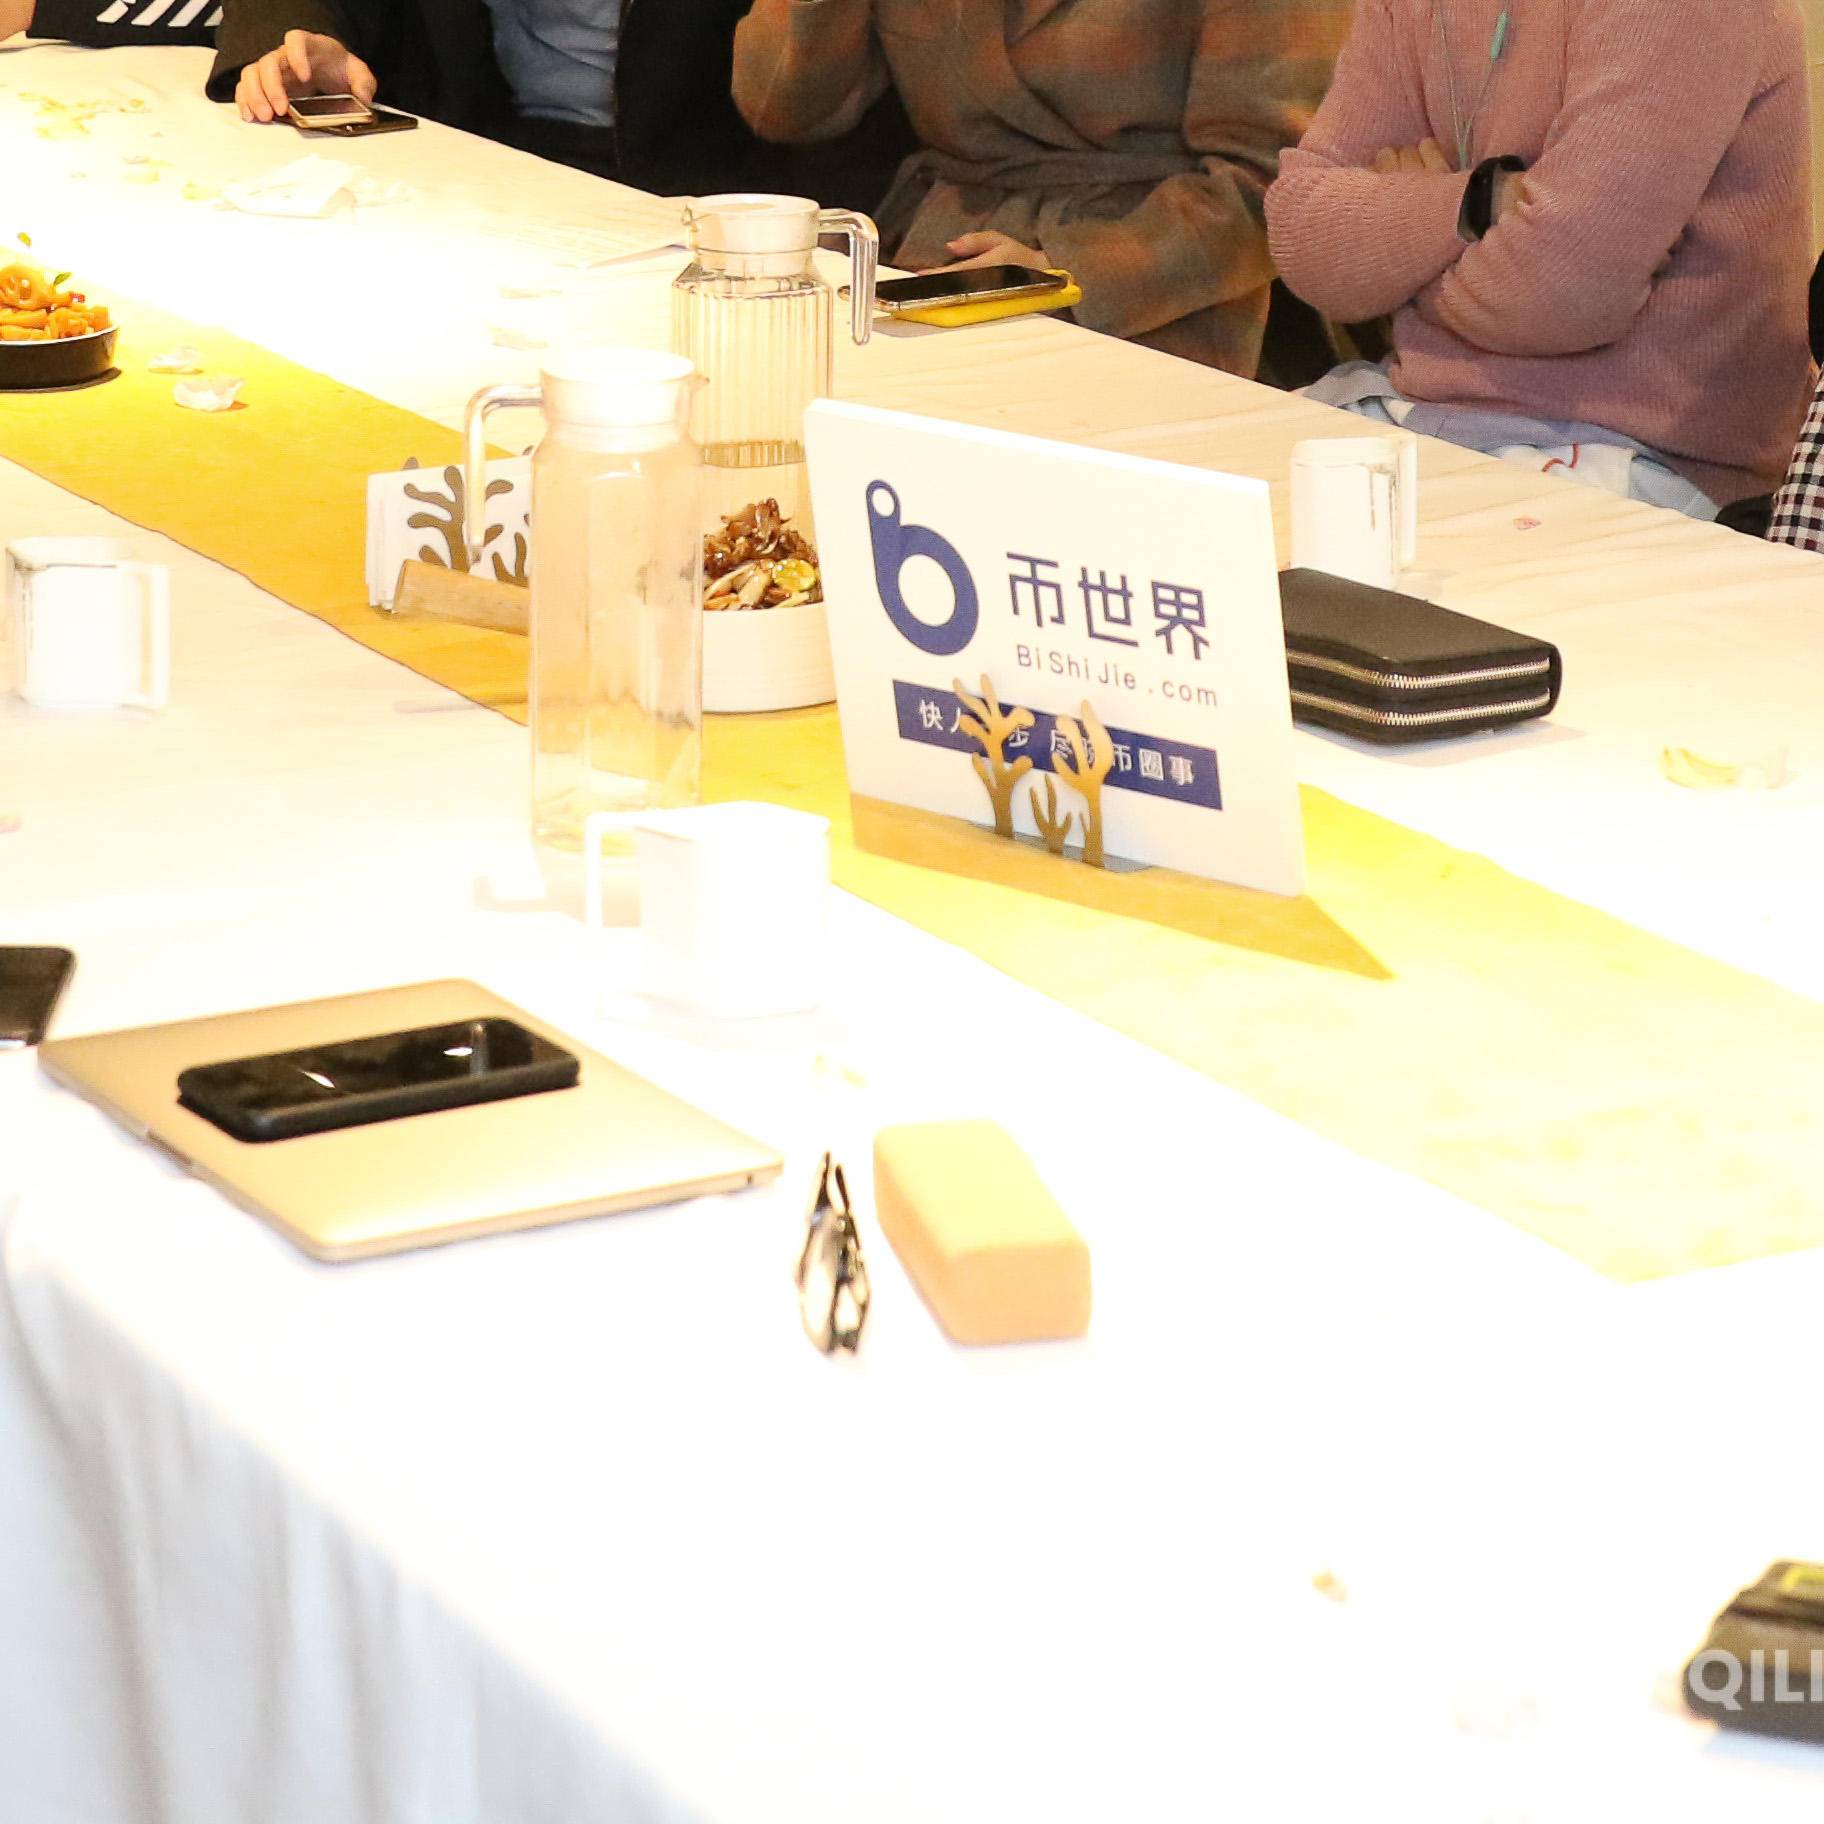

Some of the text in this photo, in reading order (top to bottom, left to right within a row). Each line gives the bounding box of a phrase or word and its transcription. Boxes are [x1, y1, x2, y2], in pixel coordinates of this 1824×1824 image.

[1006, 551, 1211, 661] 币世界
[1016, 643, 1219, 708] BiShiJie.com
